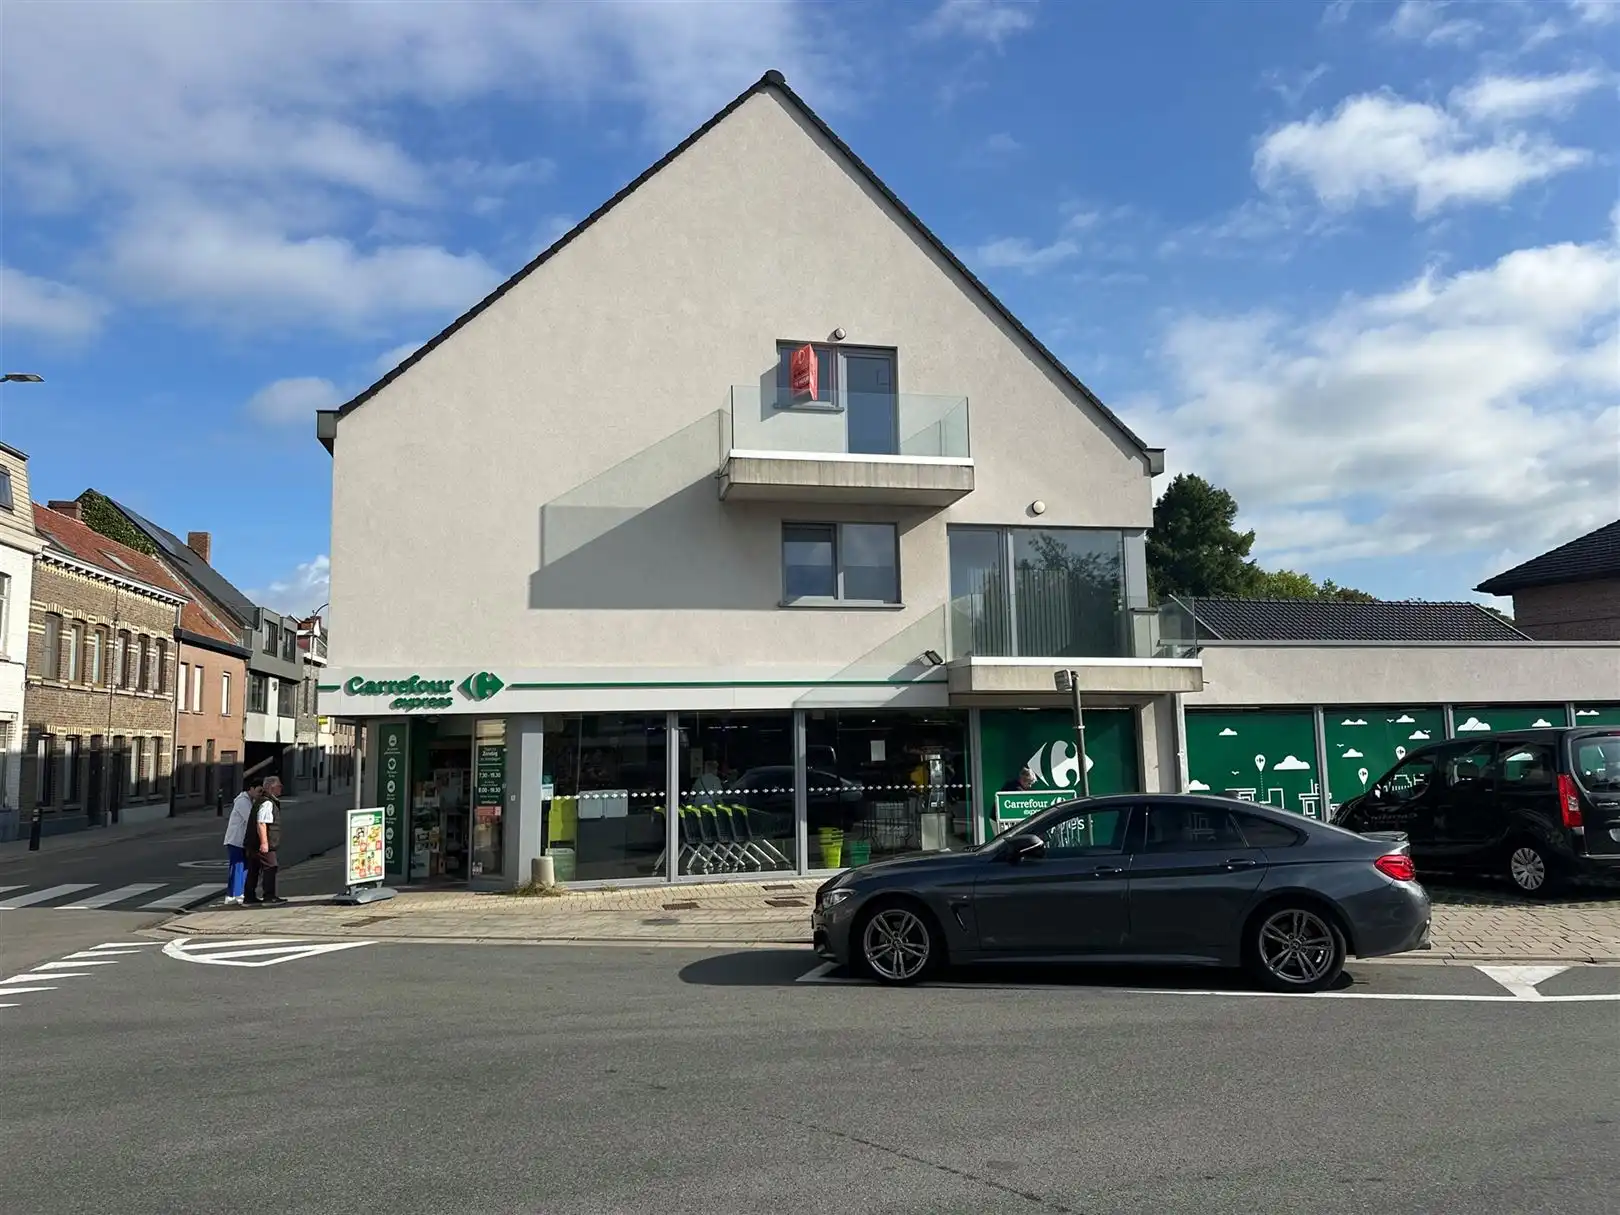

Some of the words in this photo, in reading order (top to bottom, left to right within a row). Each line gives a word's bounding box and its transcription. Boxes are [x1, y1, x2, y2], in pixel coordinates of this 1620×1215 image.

[345, 675, 455, 696] Carrefour
[391, 697, 453, 712] express
[1004, 798, 1048, 809] Carrefour
